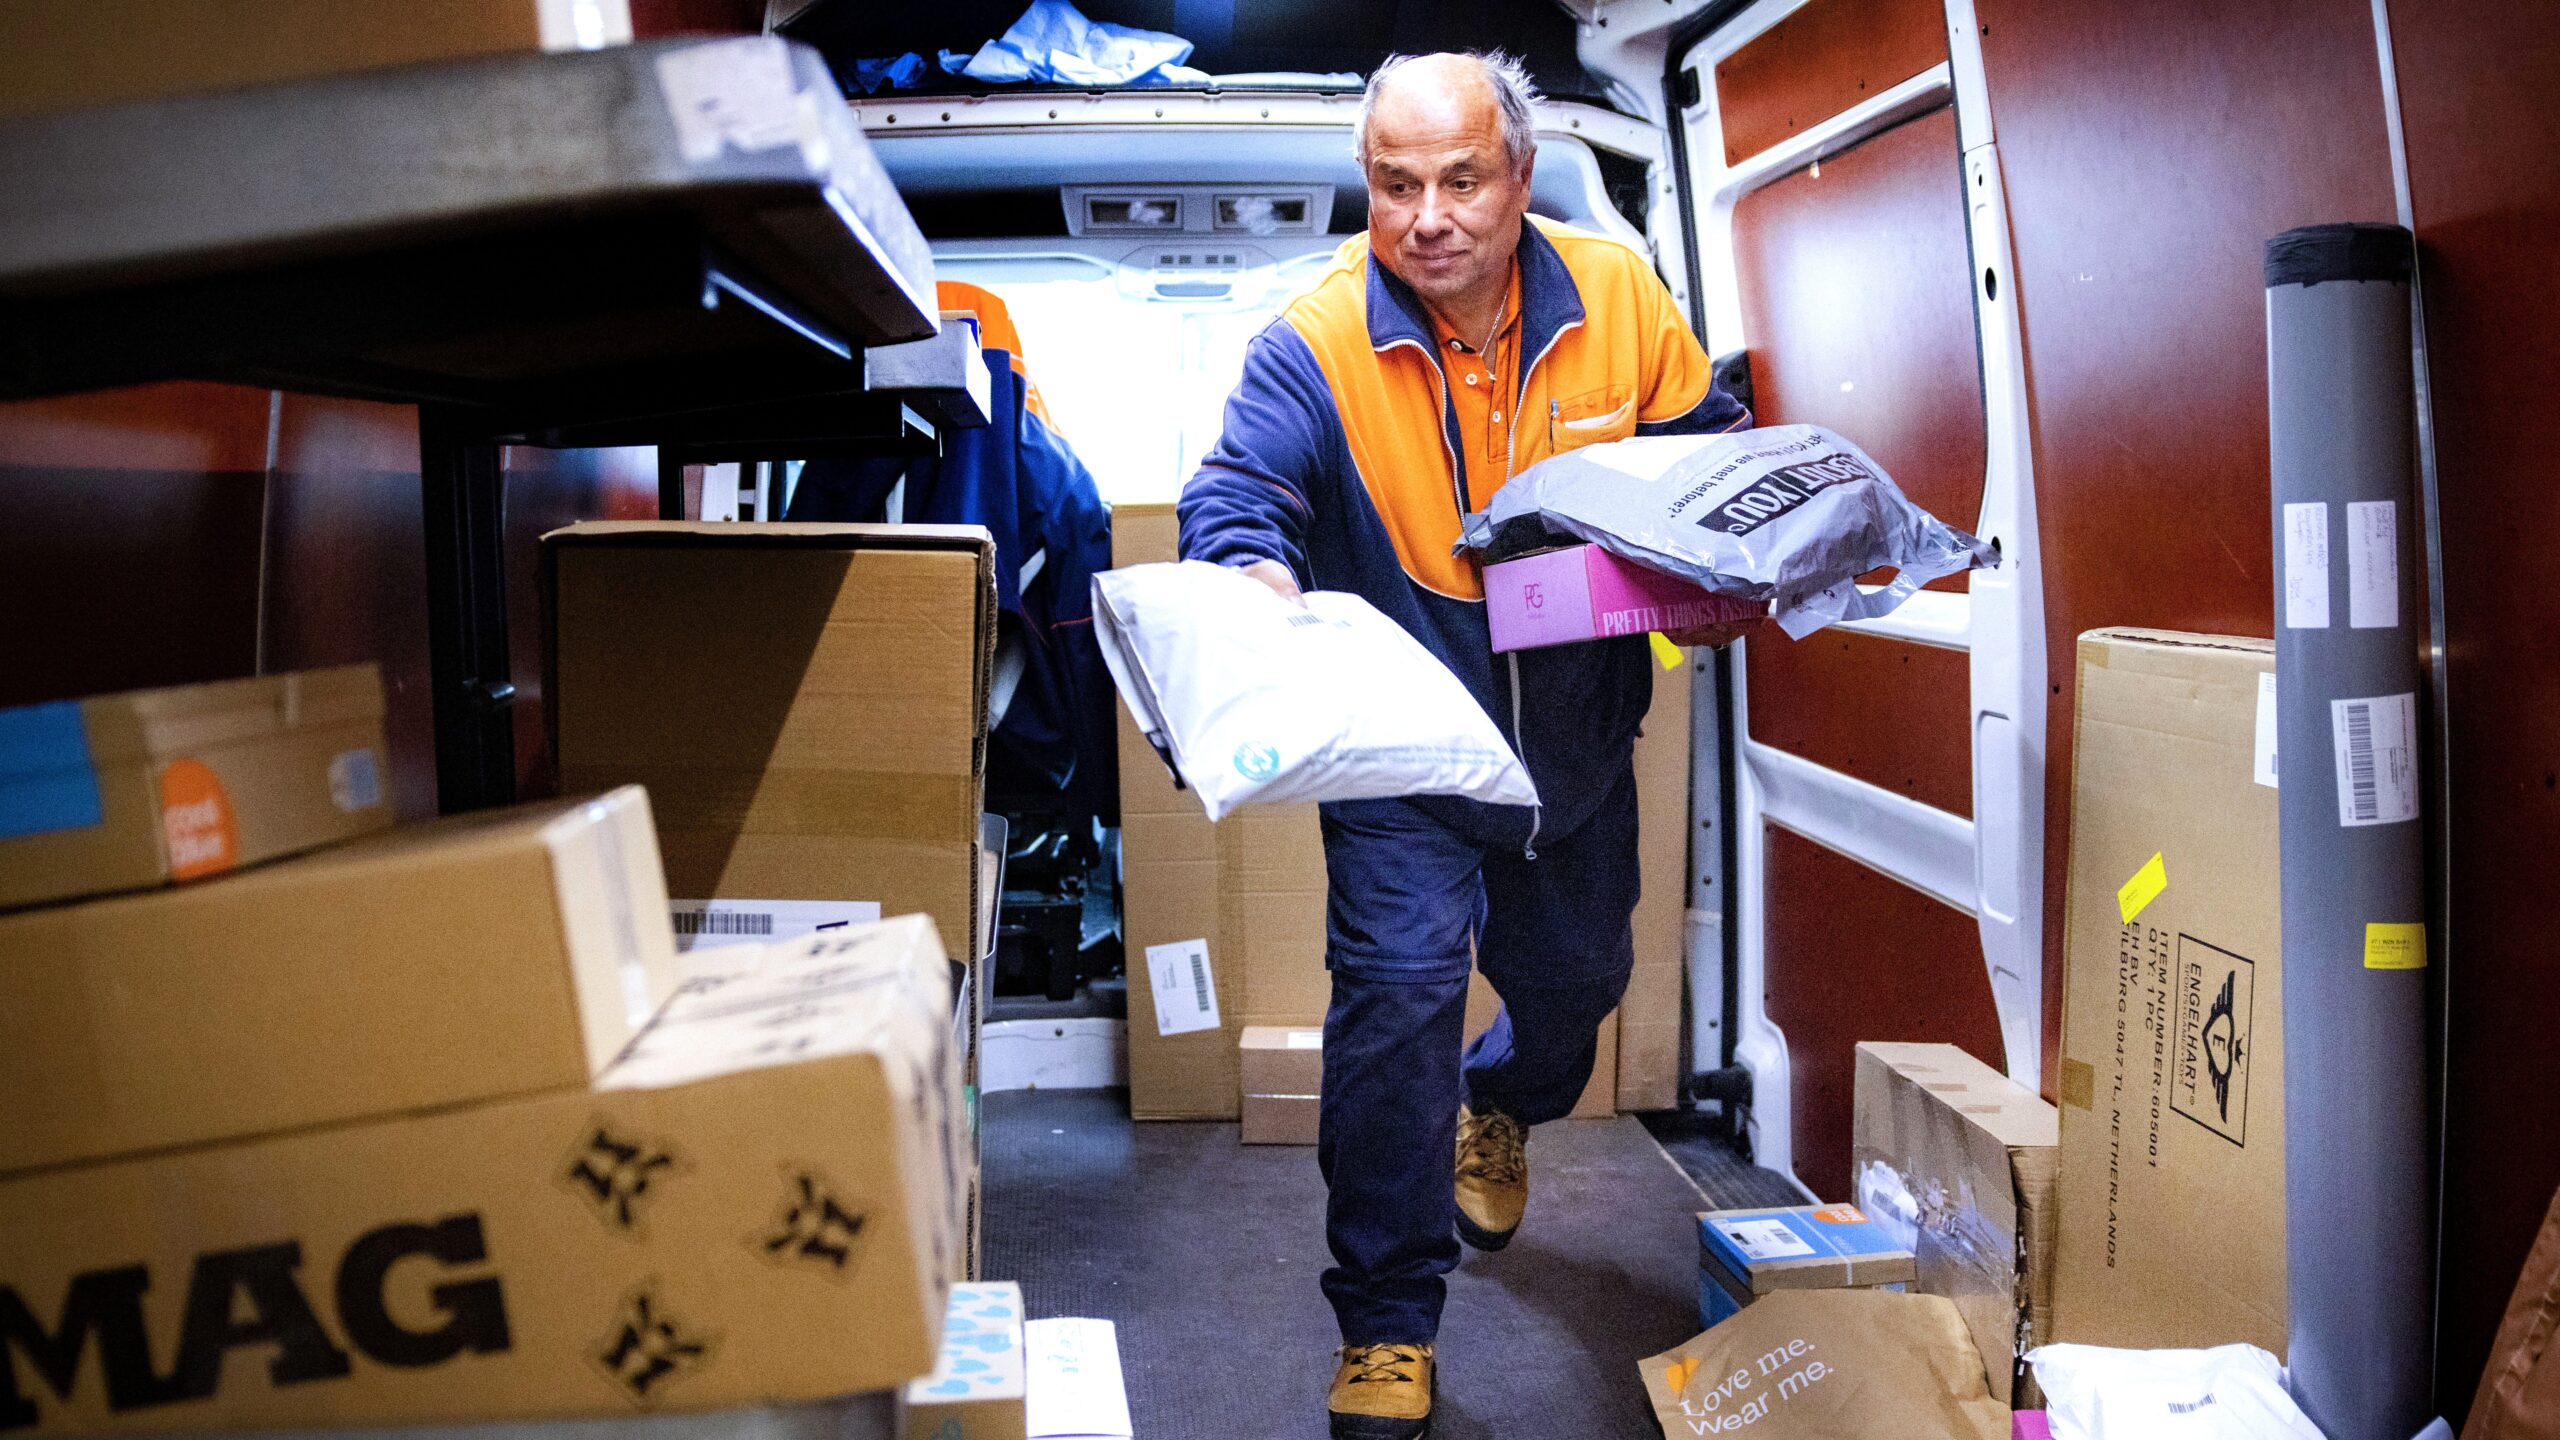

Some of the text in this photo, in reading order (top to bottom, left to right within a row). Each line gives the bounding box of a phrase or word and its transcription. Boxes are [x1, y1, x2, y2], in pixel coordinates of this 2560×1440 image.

[1711, 464, 1738, 480] met
[1735, 454, 1756, 464] we
[1603, 606, 1660, 637] PRETTY
[1667, 600, 1717, 629] THINGS
[2130, 921, 2140, 986] EH BV
[2147, 928, 2158, 977] QTY:
[2157, 931, 2169, 985] ITEM
[2145, 1001, 2155, 1031] PC
[2115, 1020, 2126, 1068] 5047
[2111, 1073, 2123, 1101] TL,
[2107, 1109, 2121, 1269] NETHERLANDS
[0, 1210, 512, 1432] MAG
[1679, 1338, 1816, 1417] Love me.
[1777, 1361, 1834, 1401] me.
